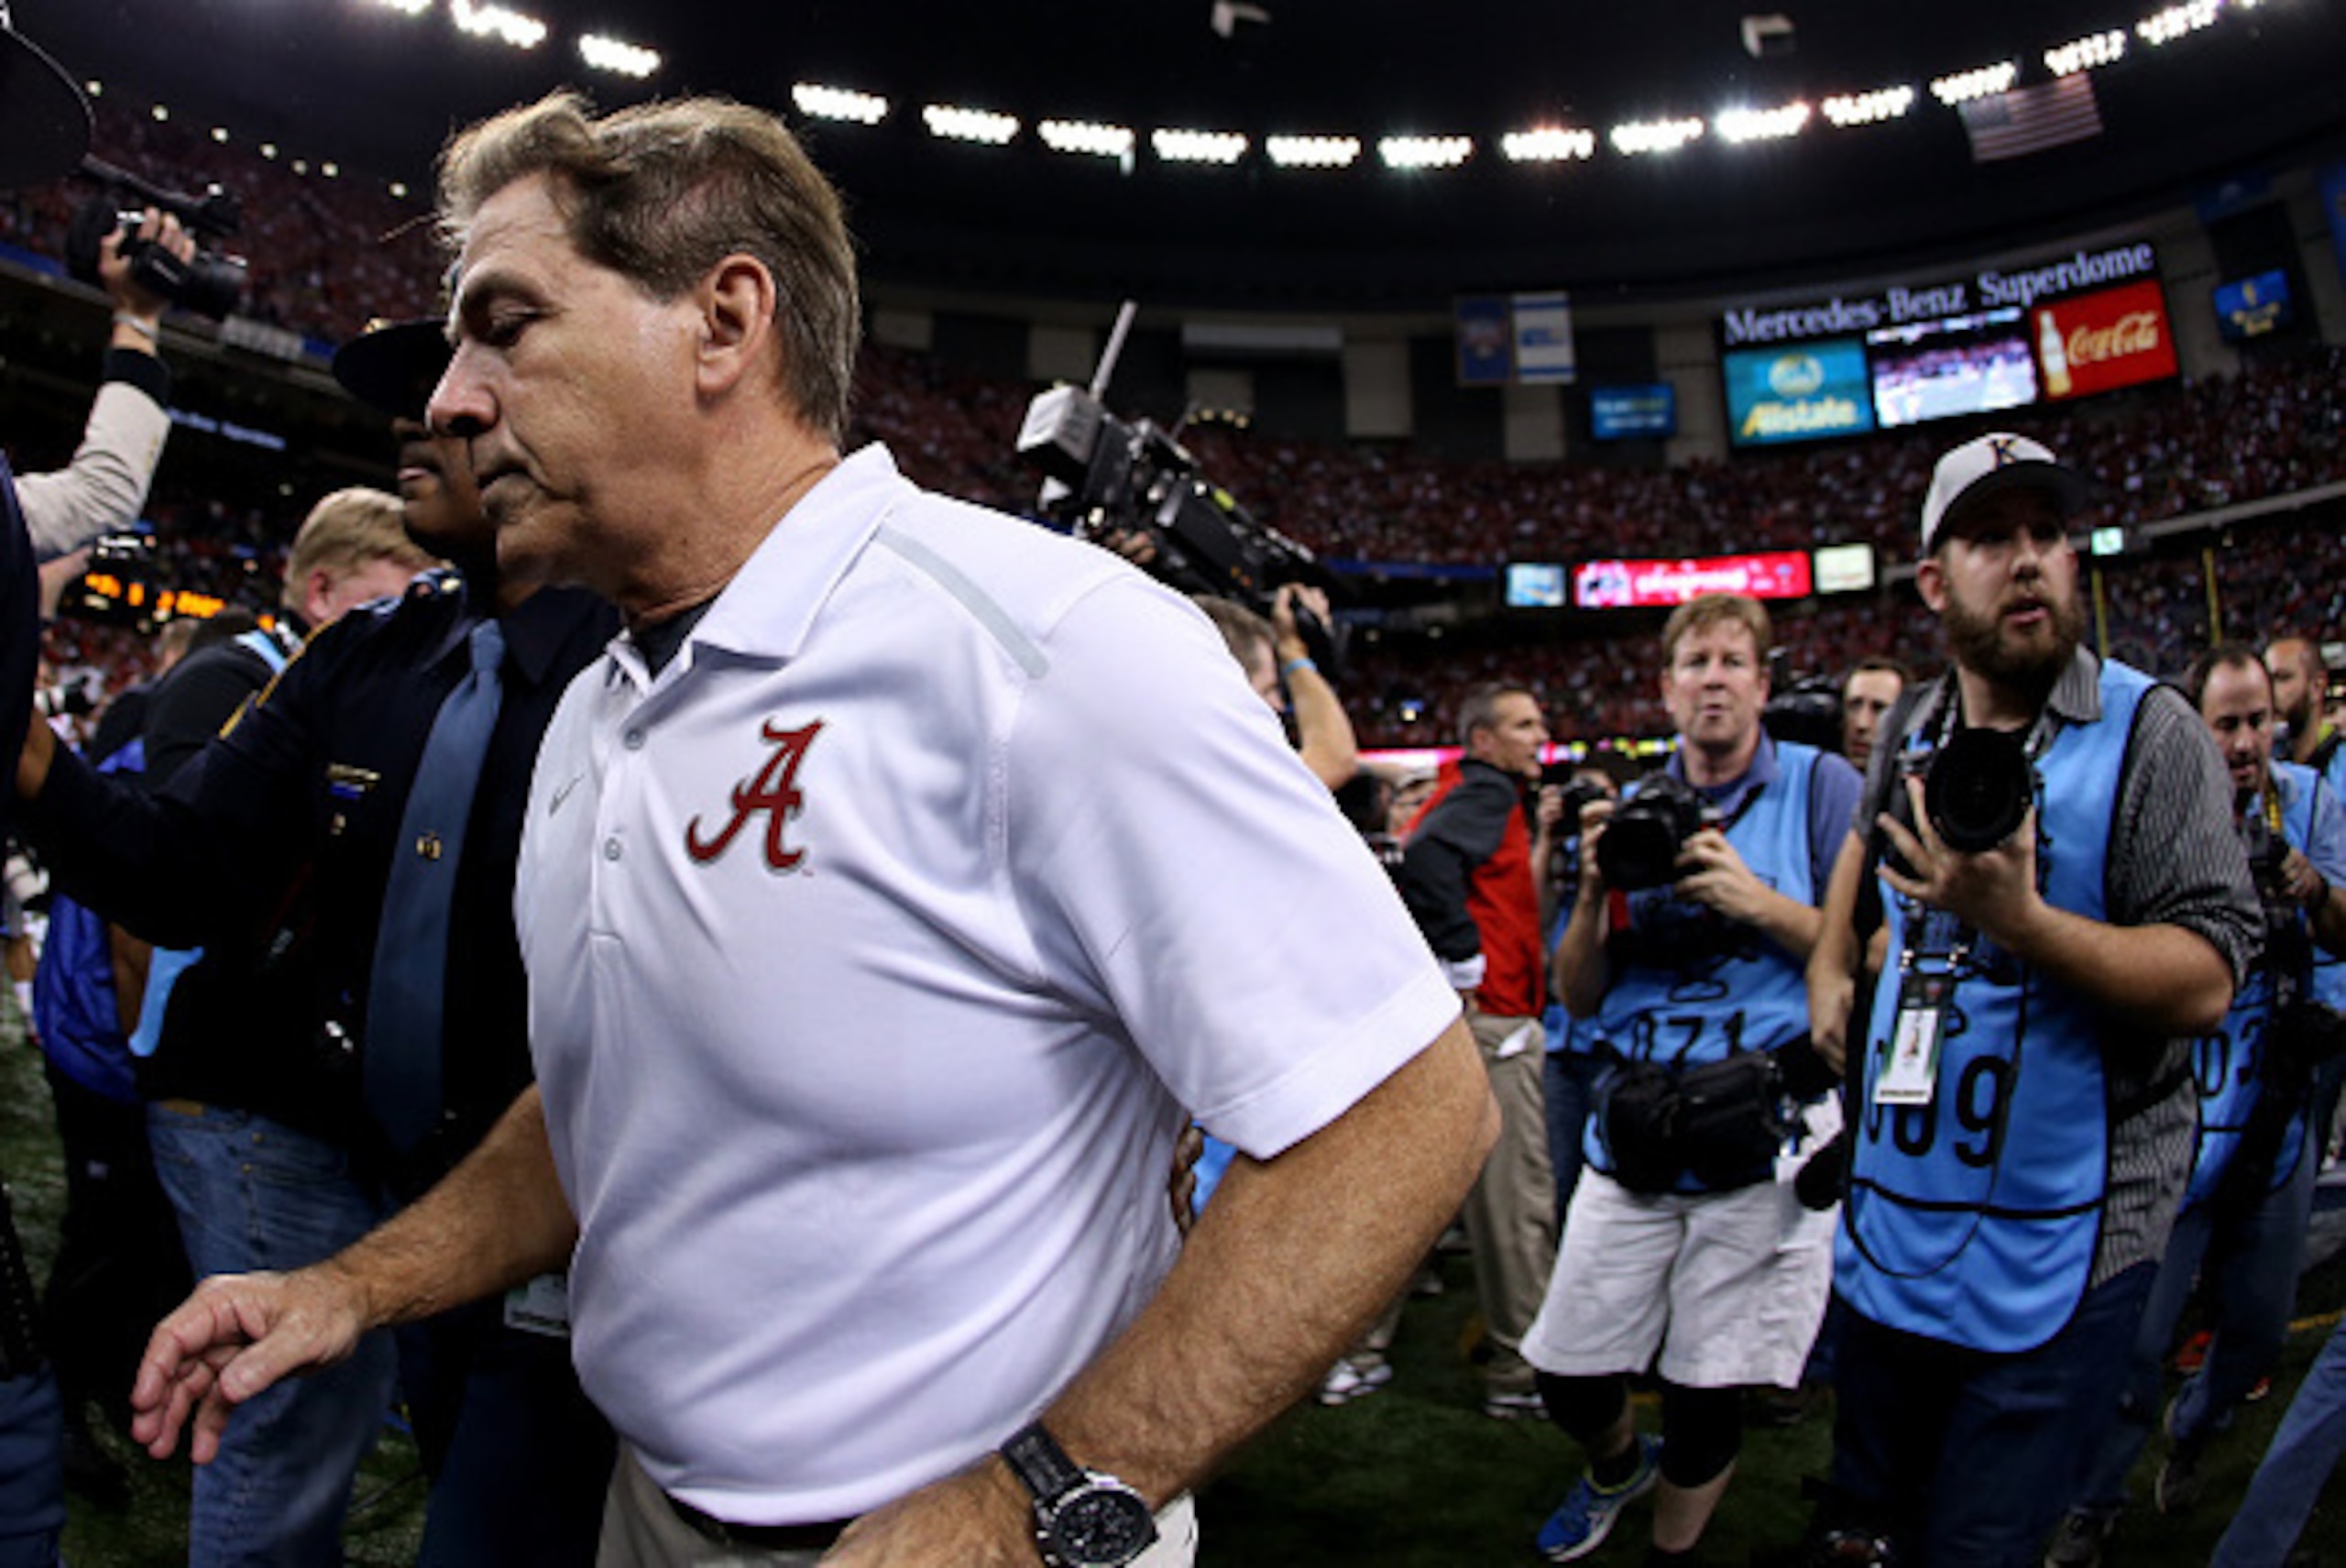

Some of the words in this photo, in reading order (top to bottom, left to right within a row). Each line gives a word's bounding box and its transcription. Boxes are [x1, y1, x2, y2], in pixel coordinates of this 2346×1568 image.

[1724, 284, 1968, 345] Mercedes-Benz
[1977, 243, 2154, 308] Superdome
[1743, 397, 1858, 437] Allstate
[685, 715, 825, 875] A
